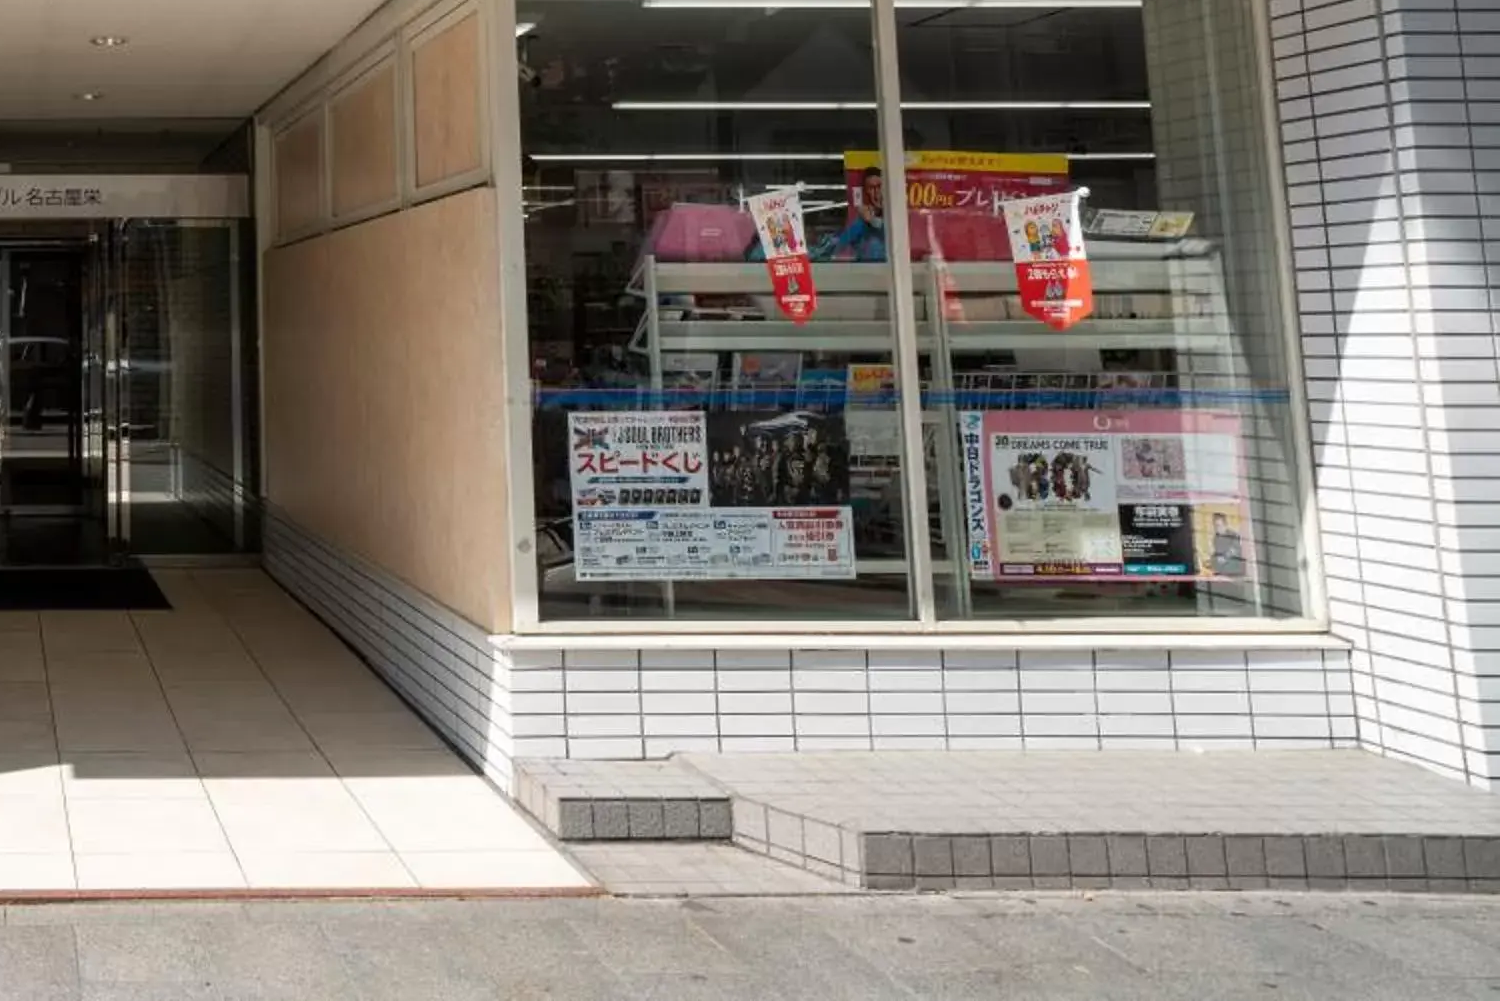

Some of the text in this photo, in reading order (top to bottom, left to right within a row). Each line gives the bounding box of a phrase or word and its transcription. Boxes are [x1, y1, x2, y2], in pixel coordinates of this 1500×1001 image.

[1011, 439, 1109, 450] DREAMS COME TRUE
[577, 450, 702, 474] スピードくじ
[964, 433, 985, 531] 中日ドラゴンズ
